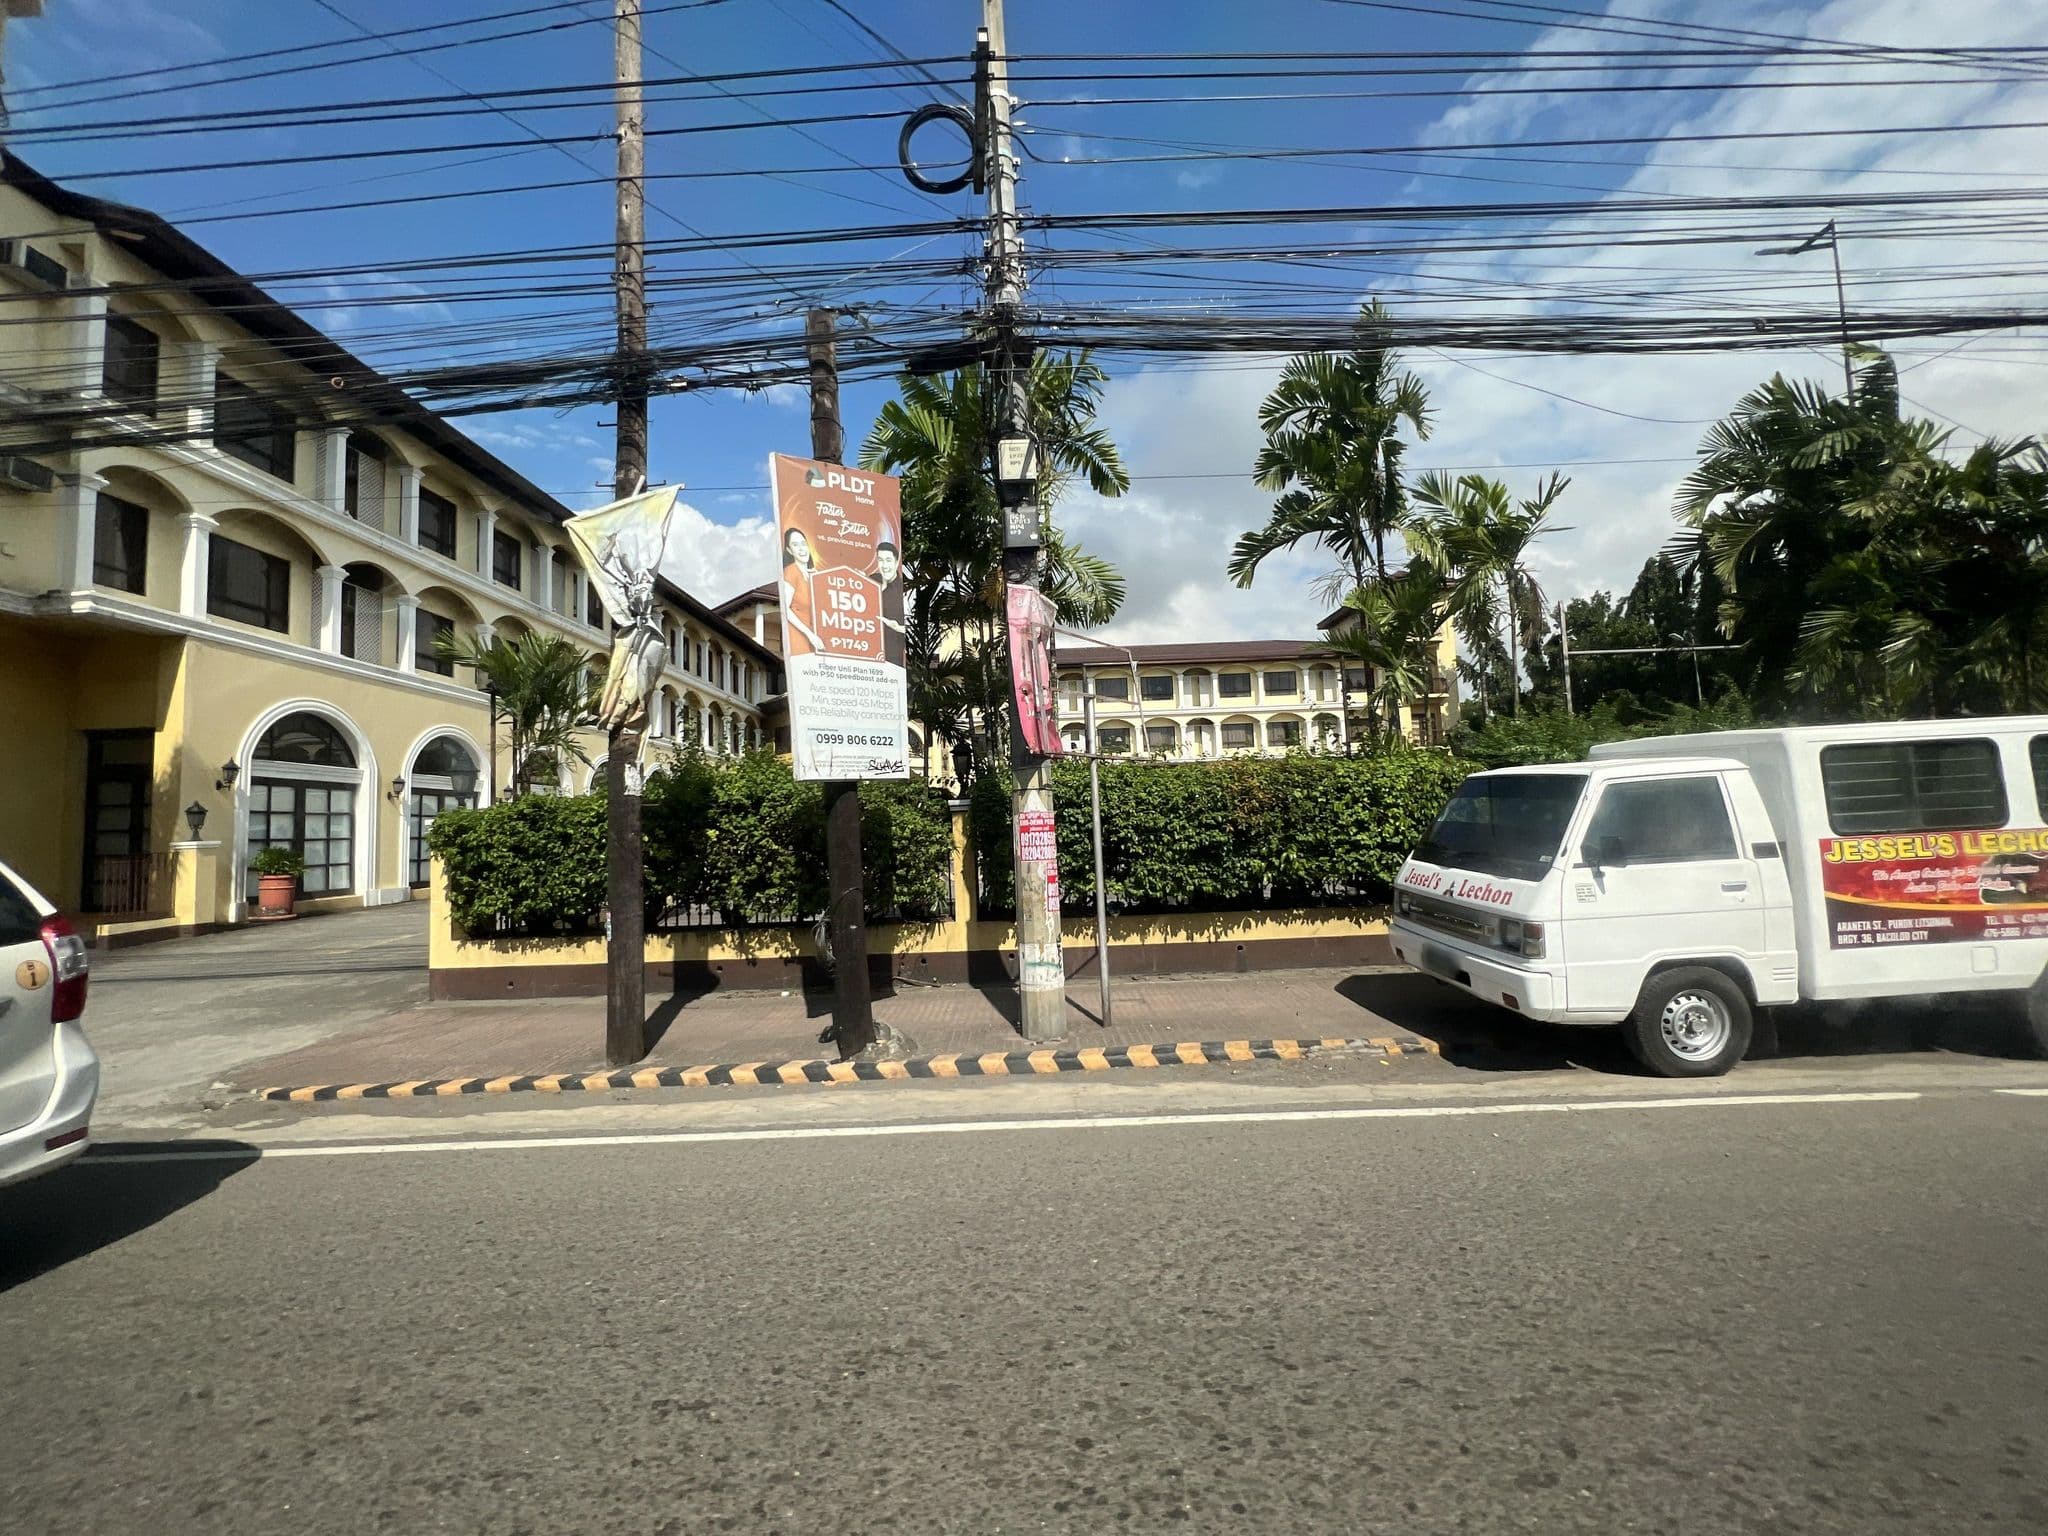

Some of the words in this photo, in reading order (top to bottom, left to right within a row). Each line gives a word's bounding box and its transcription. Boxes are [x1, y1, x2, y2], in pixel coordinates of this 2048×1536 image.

[827, 471, 875, 496] PLDT
[855, 495, 875, 506] Home
[816, 501, 846, 518] Faster
[838, 520, 870, 537] Better
[827, 535, 854, 547] previous
[855, 540, 872, 549] plans
[828, 576, 846, 589] up
[849, 577, 863, 590] to
[828, 589, 867, 613] 150
[821, 610, 876, 636] Mbps
[819, 663, 837, 671] Fiber
[853, 666, 868, 675] Plan
[803, 669, 819, 677] with
[836, 672, 874, 683] speedboost
[875, 676, 899, 684] add-on
[829, 685, 856, 698] speed
[857, 687, 870, 697] 120
[871, 688, 895, 700] Mbps
[831, 697, 857, 710] speed
[870, 700, 894, 711] Mbps
[820, 707, 861, 721] Reliability
[861, 710, 906, 721] connection
[816, 733, 844, 745] 0999
[847, 735, 867, 746] 806
[870, 735, 894, 747] 6222
[1825, 833, 1957, 863] JESSEL'S
[1404, 868, 1441, 890] Jessel's
[1457, 879, 1513, 905] Lechon
[1837, 921, 1871, 931] ARANETA
[1876, 932, 1910, 942] BACOLOD
[1911, 931, 1928, 941] CITY
